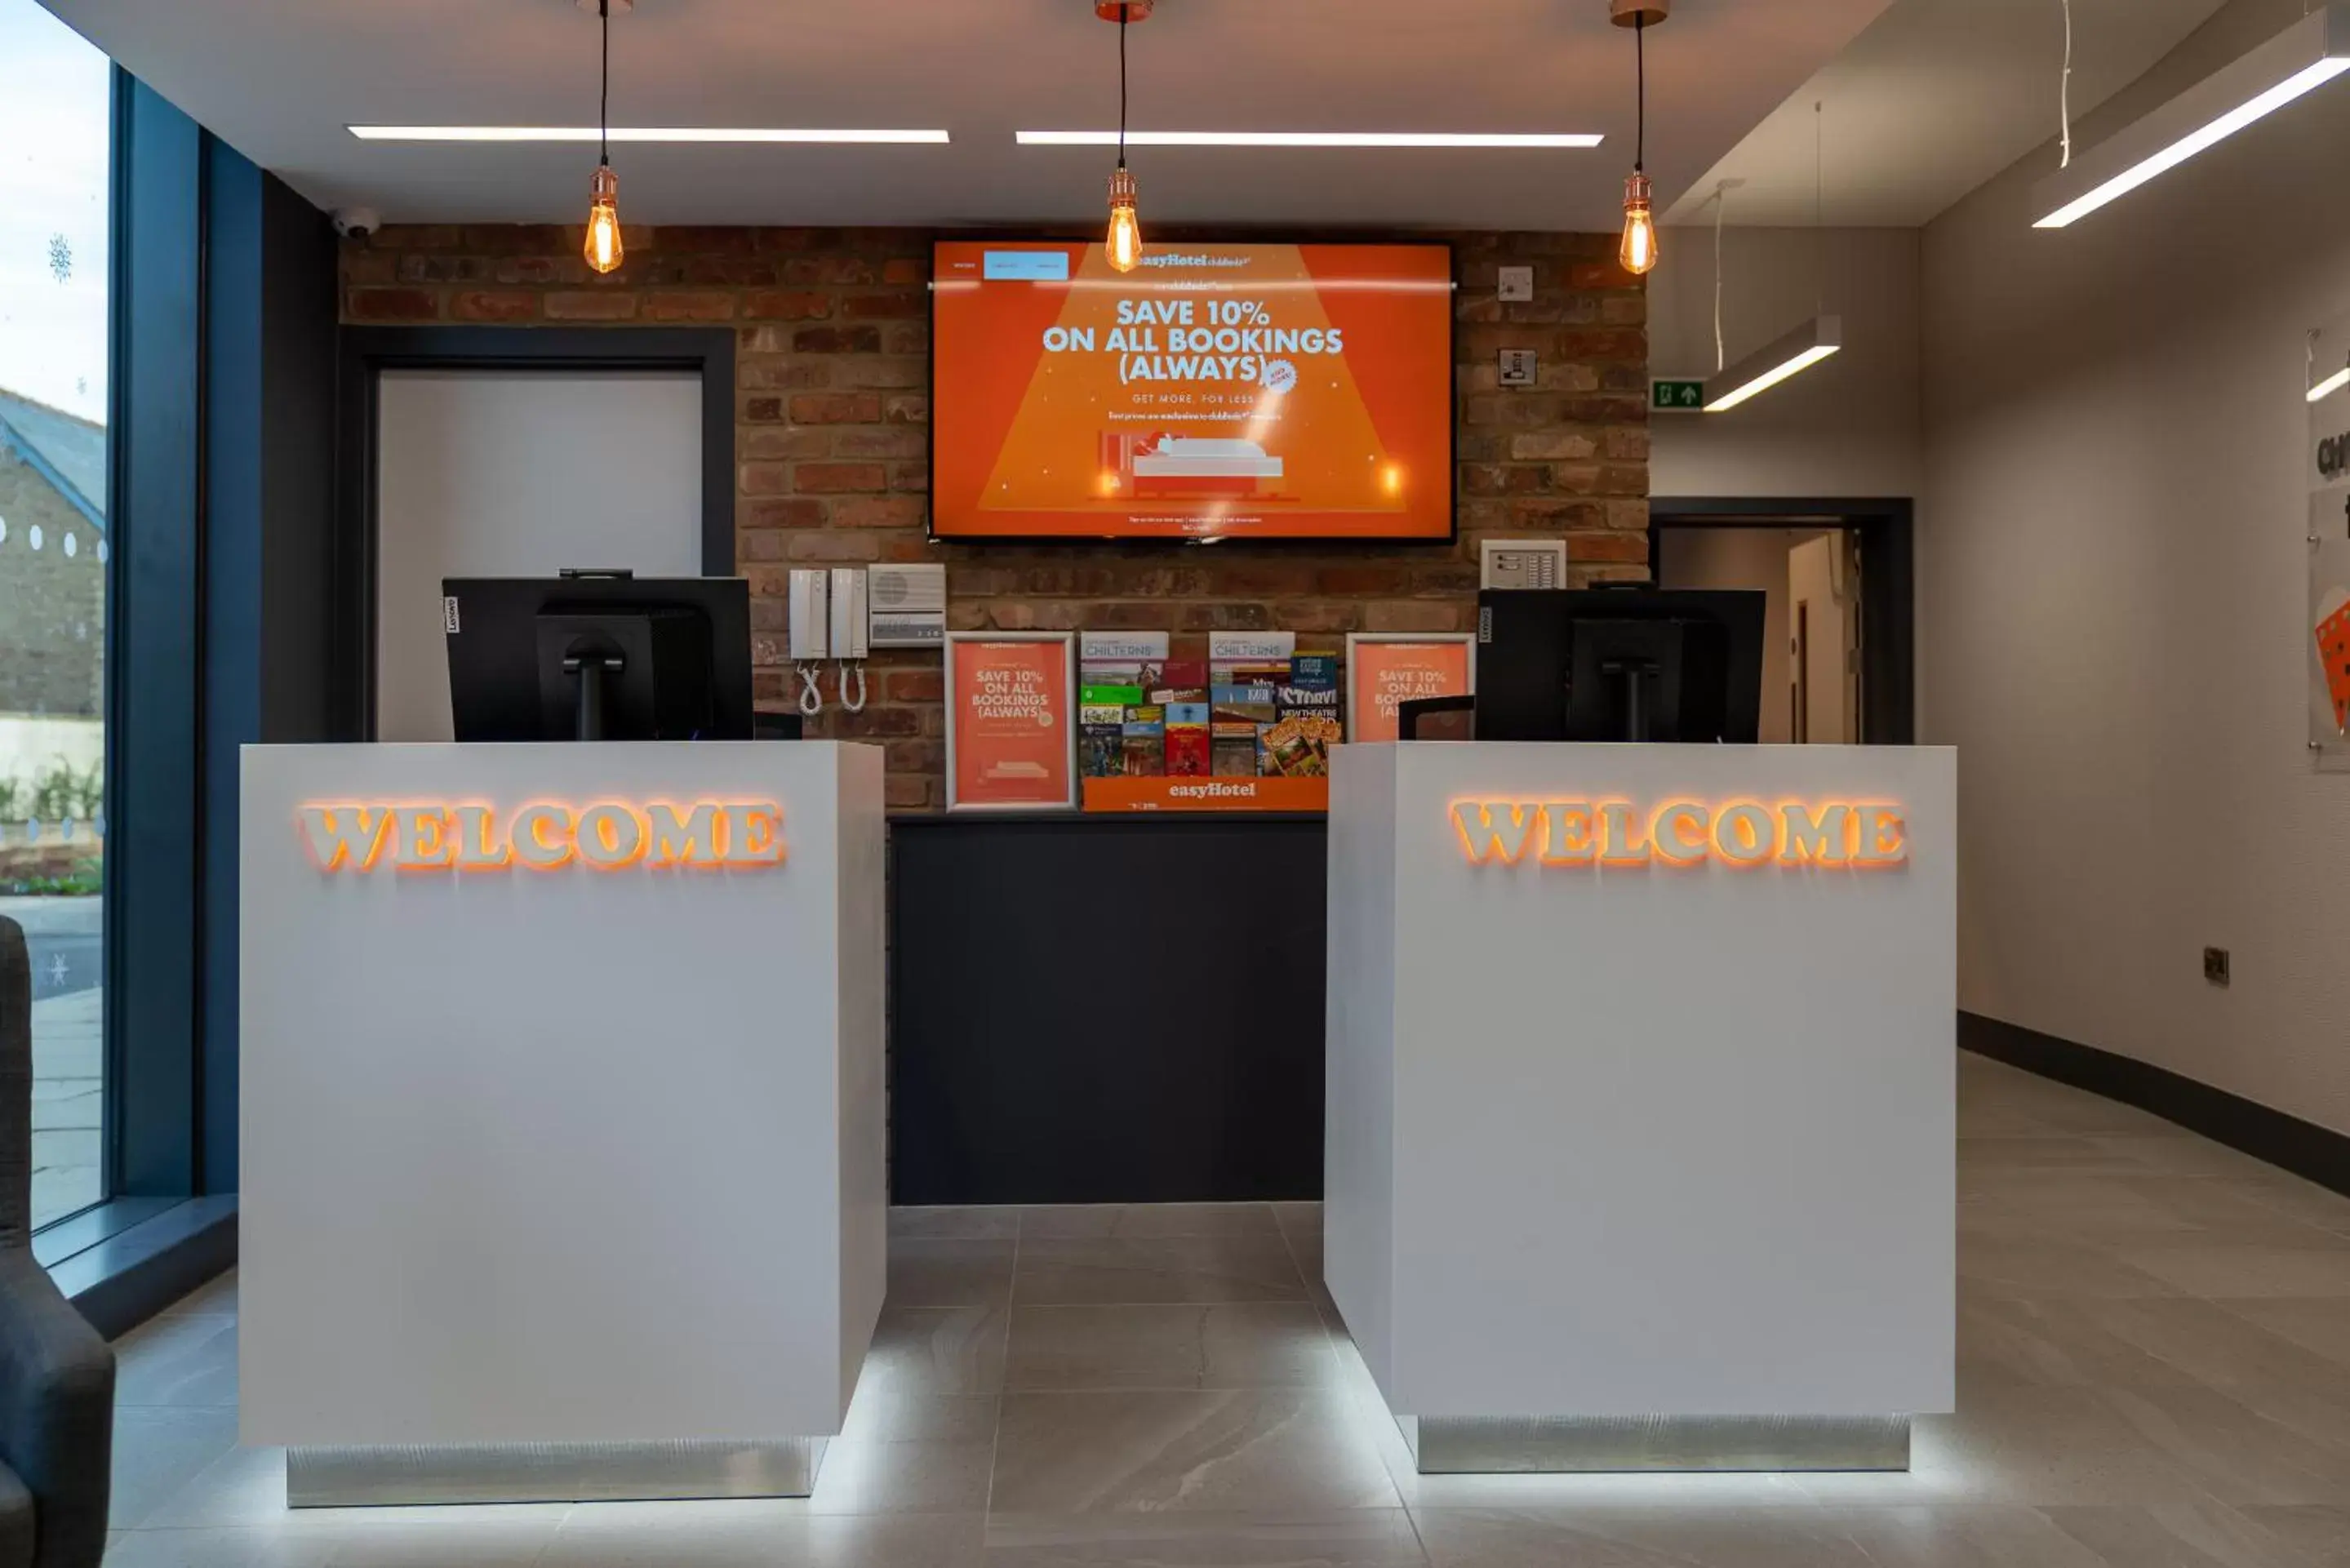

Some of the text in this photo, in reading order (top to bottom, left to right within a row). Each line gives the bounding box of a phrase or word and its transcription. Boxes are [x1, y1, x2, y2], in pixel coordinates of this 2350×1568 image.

[1117, 300, 1270, 326] SAVE 10%
[1042, 327, 1343, 353] ON ALL BOOKINGS
[1119, 354, 1266, 386] (ALWAYS)
[1132, 393, 1154, 404] GET
[1085, 645, 1153, 656] CHILTERNS
[1215, 645, 1281, 656] CHILTERNS
[977, 670, 1044, 683] SAVE 10%
[1378, 670, 1447, 683] SAVE 10%
[984, 683, 1036, 694] ON ALL
[1388, 683, 1437, 694] ON ALL
[972, 694, 1049, 706] BOOKINGS
[1169, 782, 1257, 799] easyHotel
[297, 803, 785, 871] WELCOME
[1450, 800, 1908, 865] WELCOME
